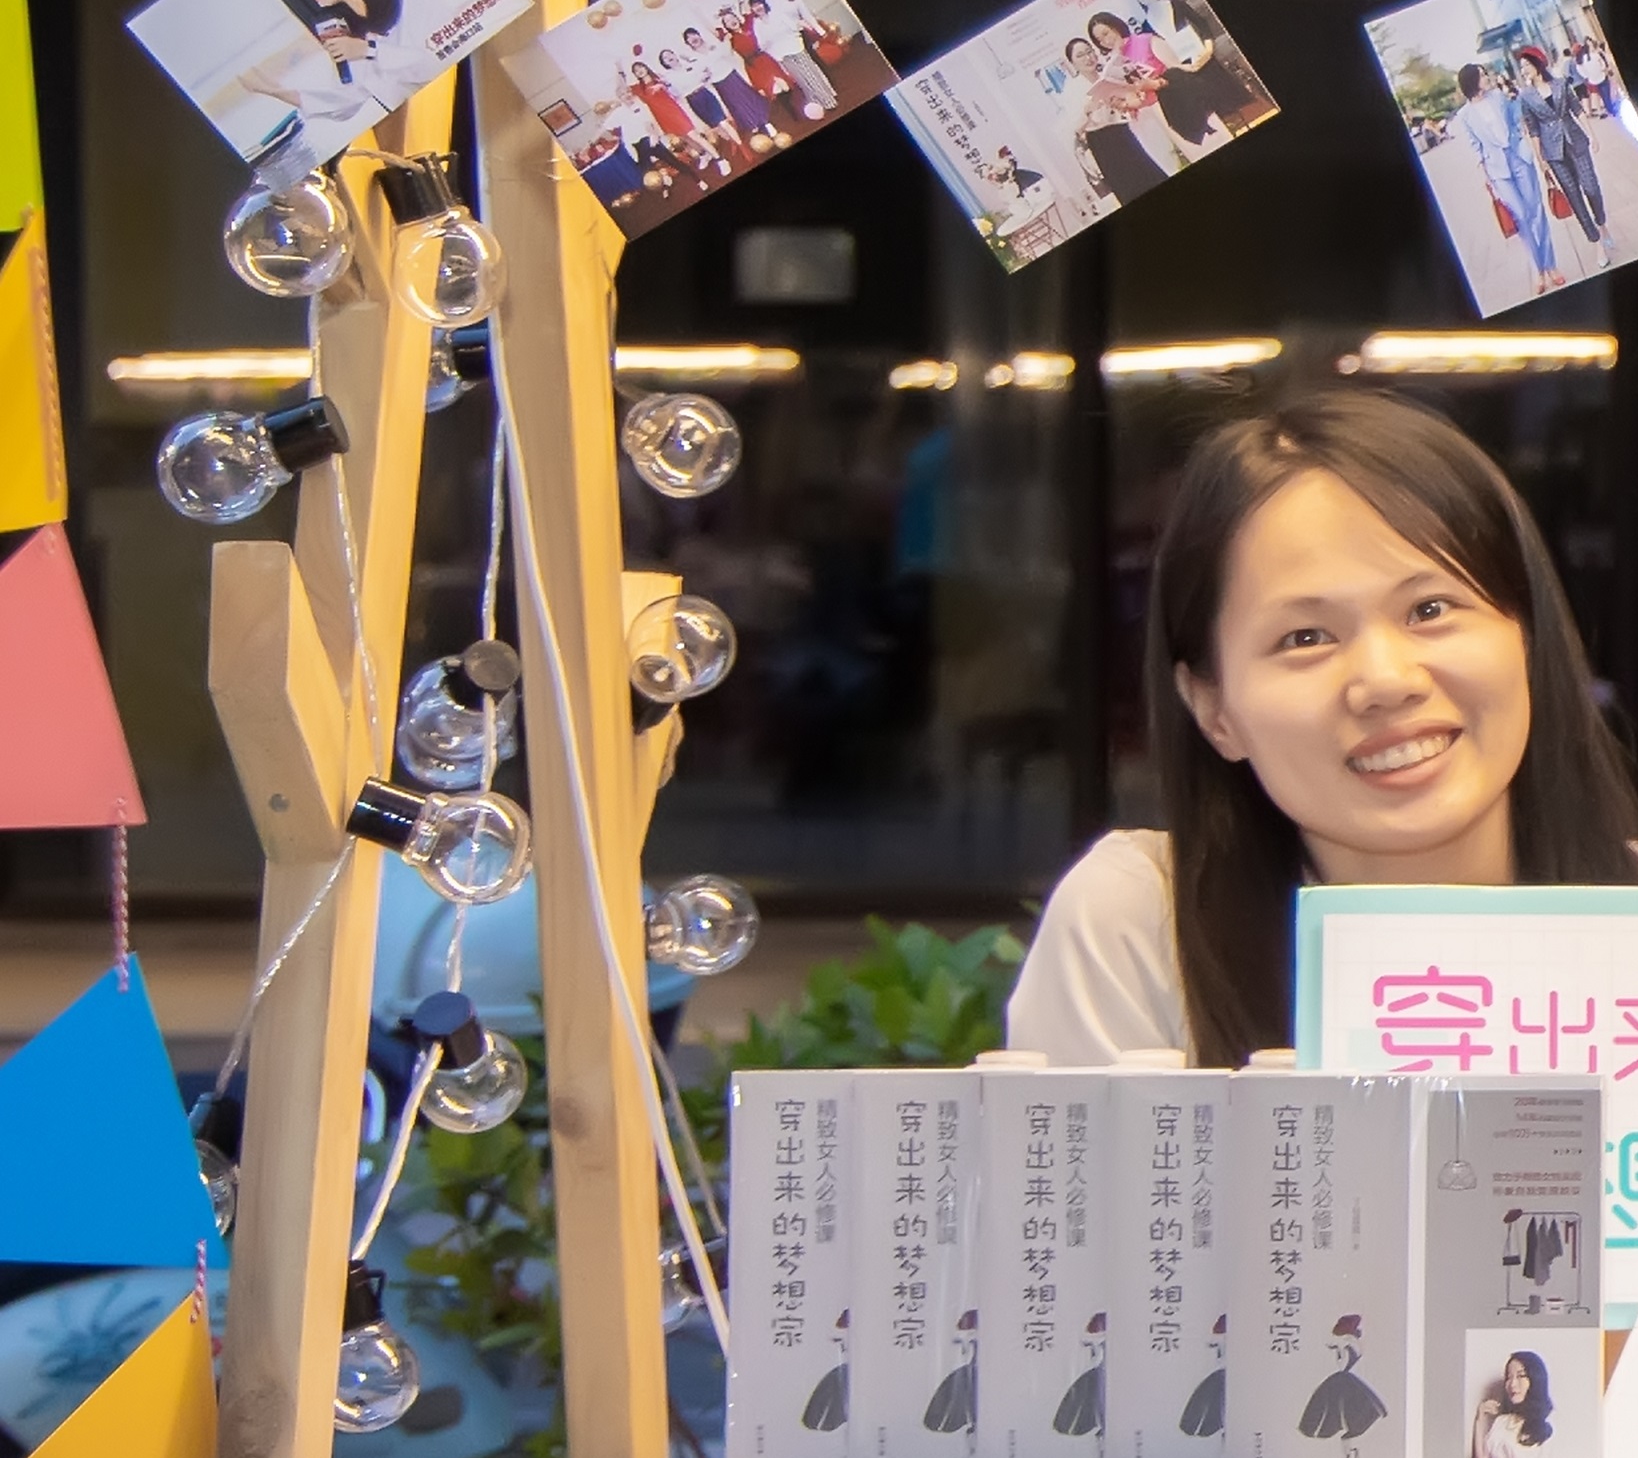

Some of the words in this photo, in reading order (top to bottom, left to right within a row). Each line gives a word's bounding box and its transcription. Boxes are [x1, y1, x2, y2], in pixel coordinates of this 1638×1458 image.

[771, 1099, 807, 1347] 穿出来的梦想家
[892, 1101, 927, 1350] 穿出来的梦想家
[1022, 1103, 1057, 1353] 穿出来的梦想家
[1149, 1102, 1184, 1354] 穿出来的梦想家
[1269, 1104, 1304, 1355] 穿出来的梦想家
